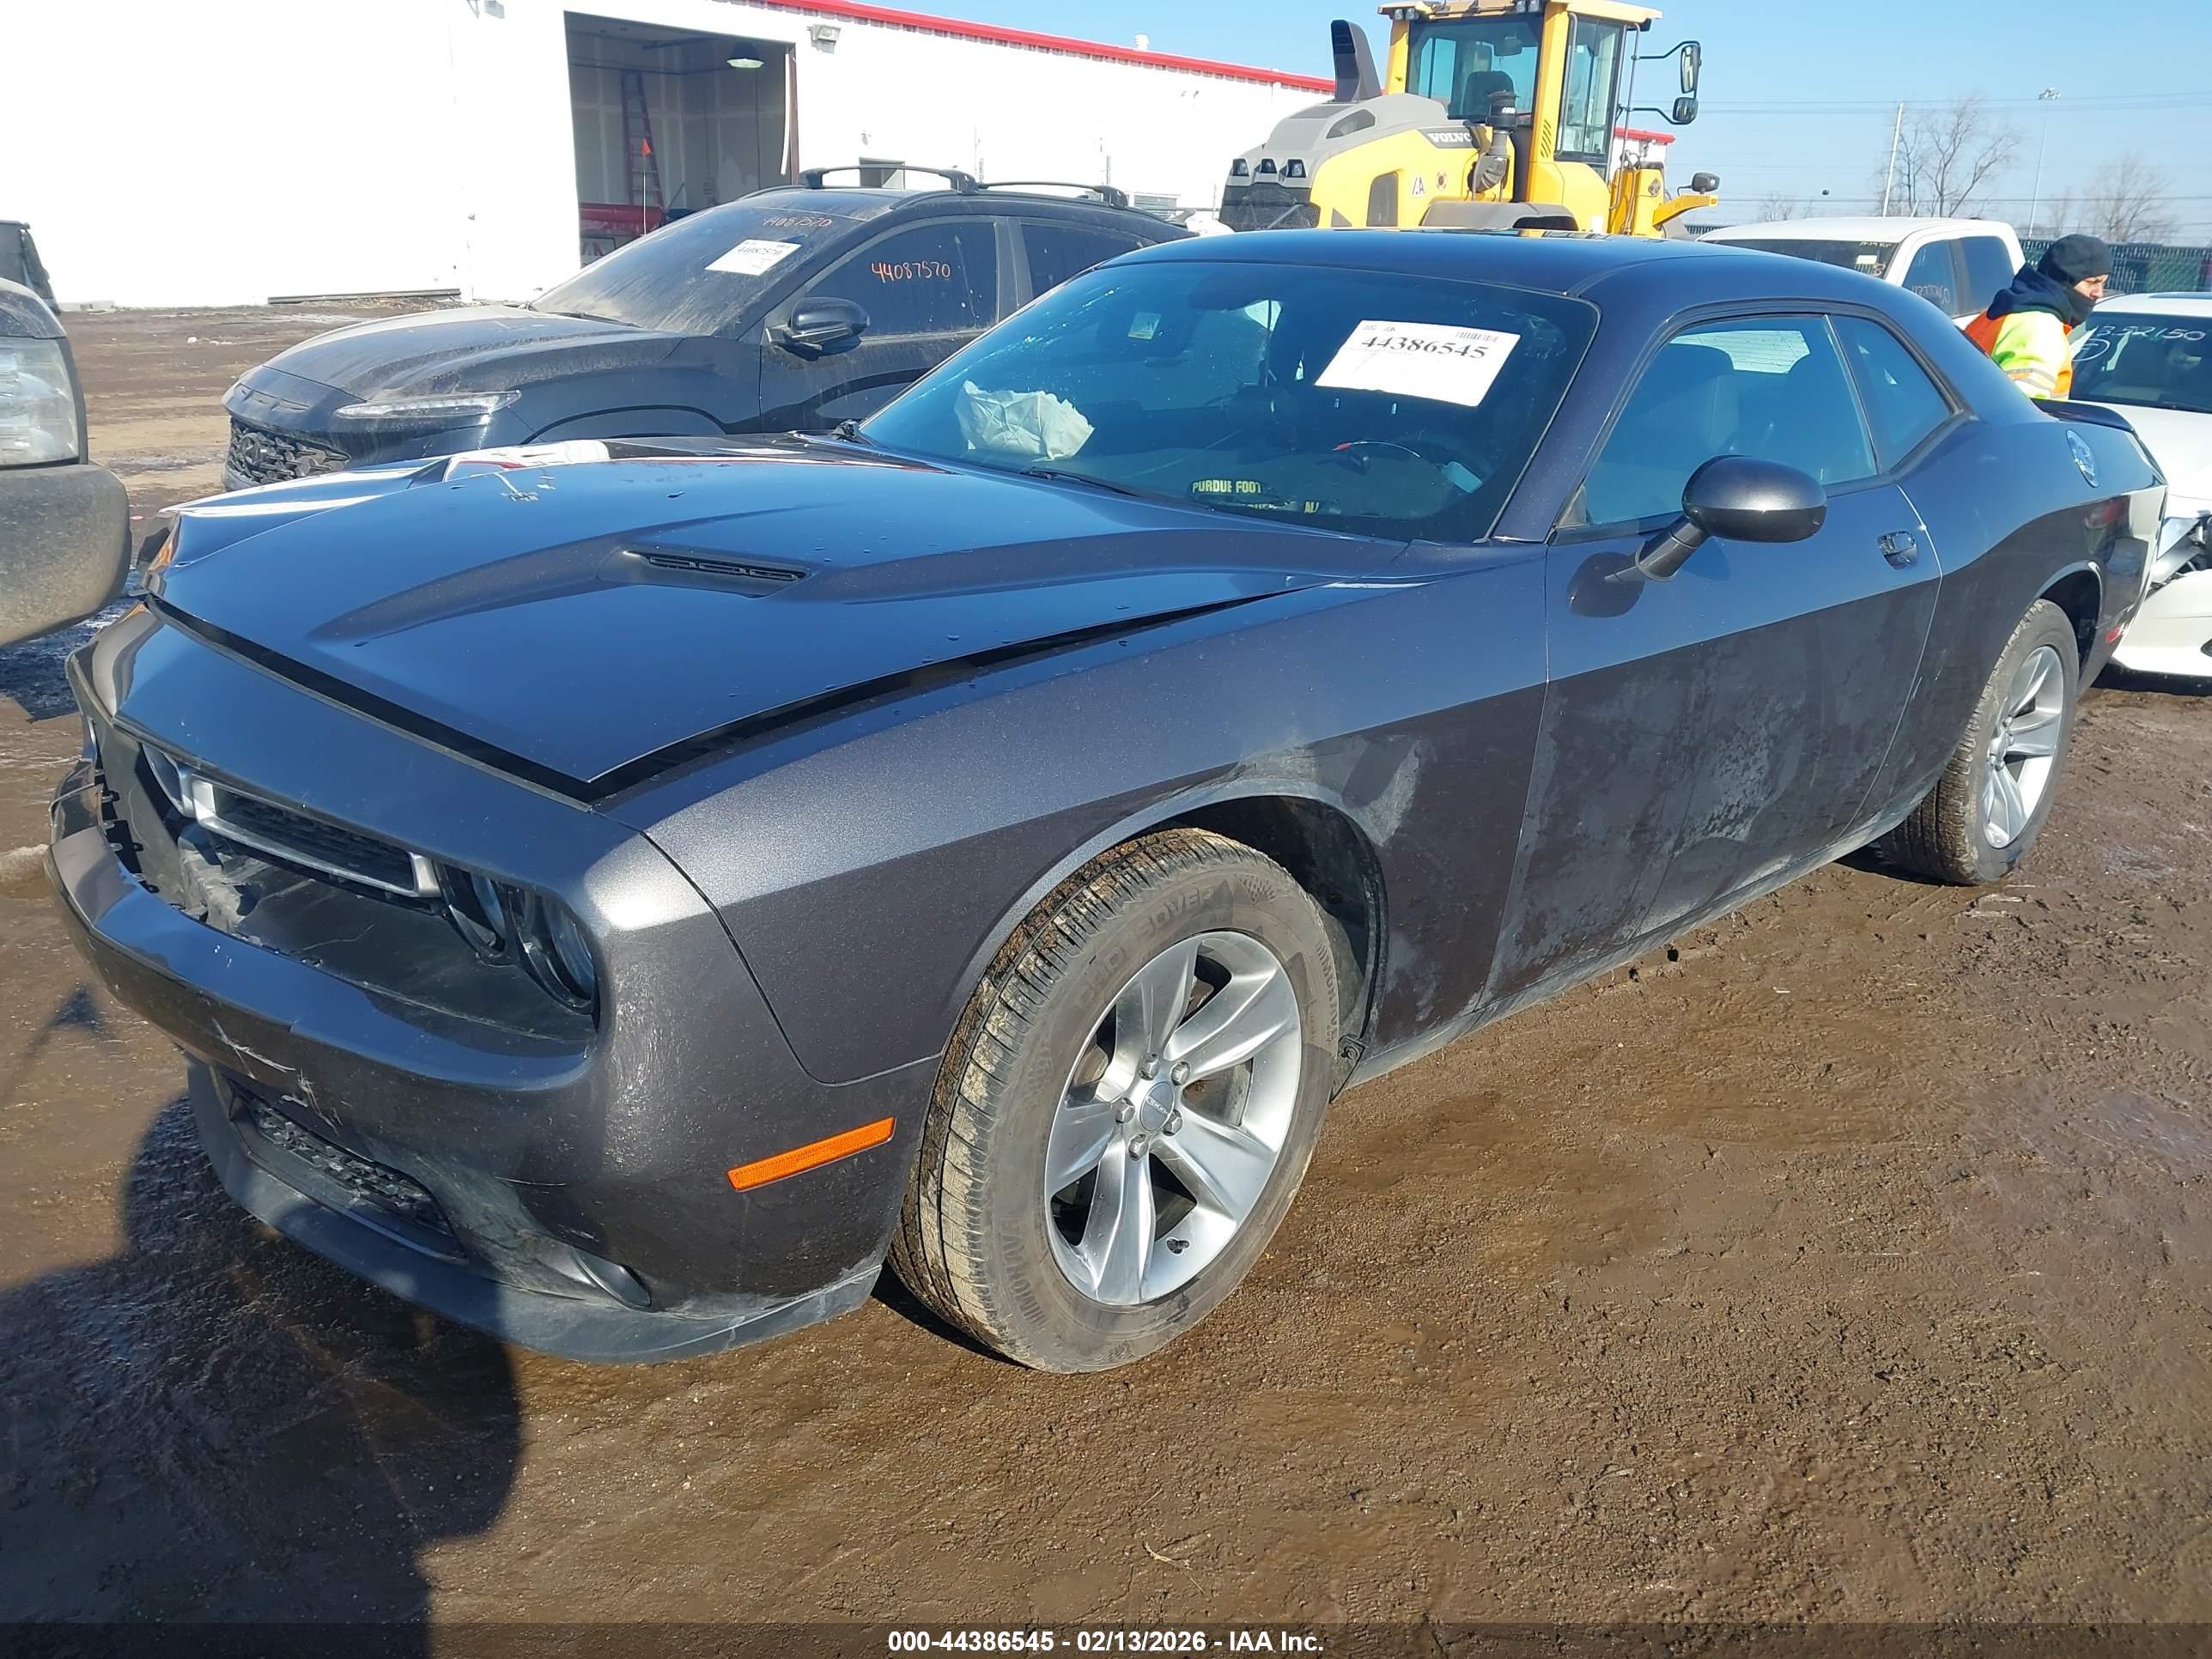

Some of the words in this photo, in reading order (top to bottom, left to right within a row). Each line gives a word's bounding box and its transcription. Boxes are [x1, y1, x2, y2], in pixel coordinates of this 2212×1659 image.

[871, 260, 951, 283] 44087570
[1361, 336, 1490, 359] 44386545
[1192, 479, 1232, 494] PURDUE
